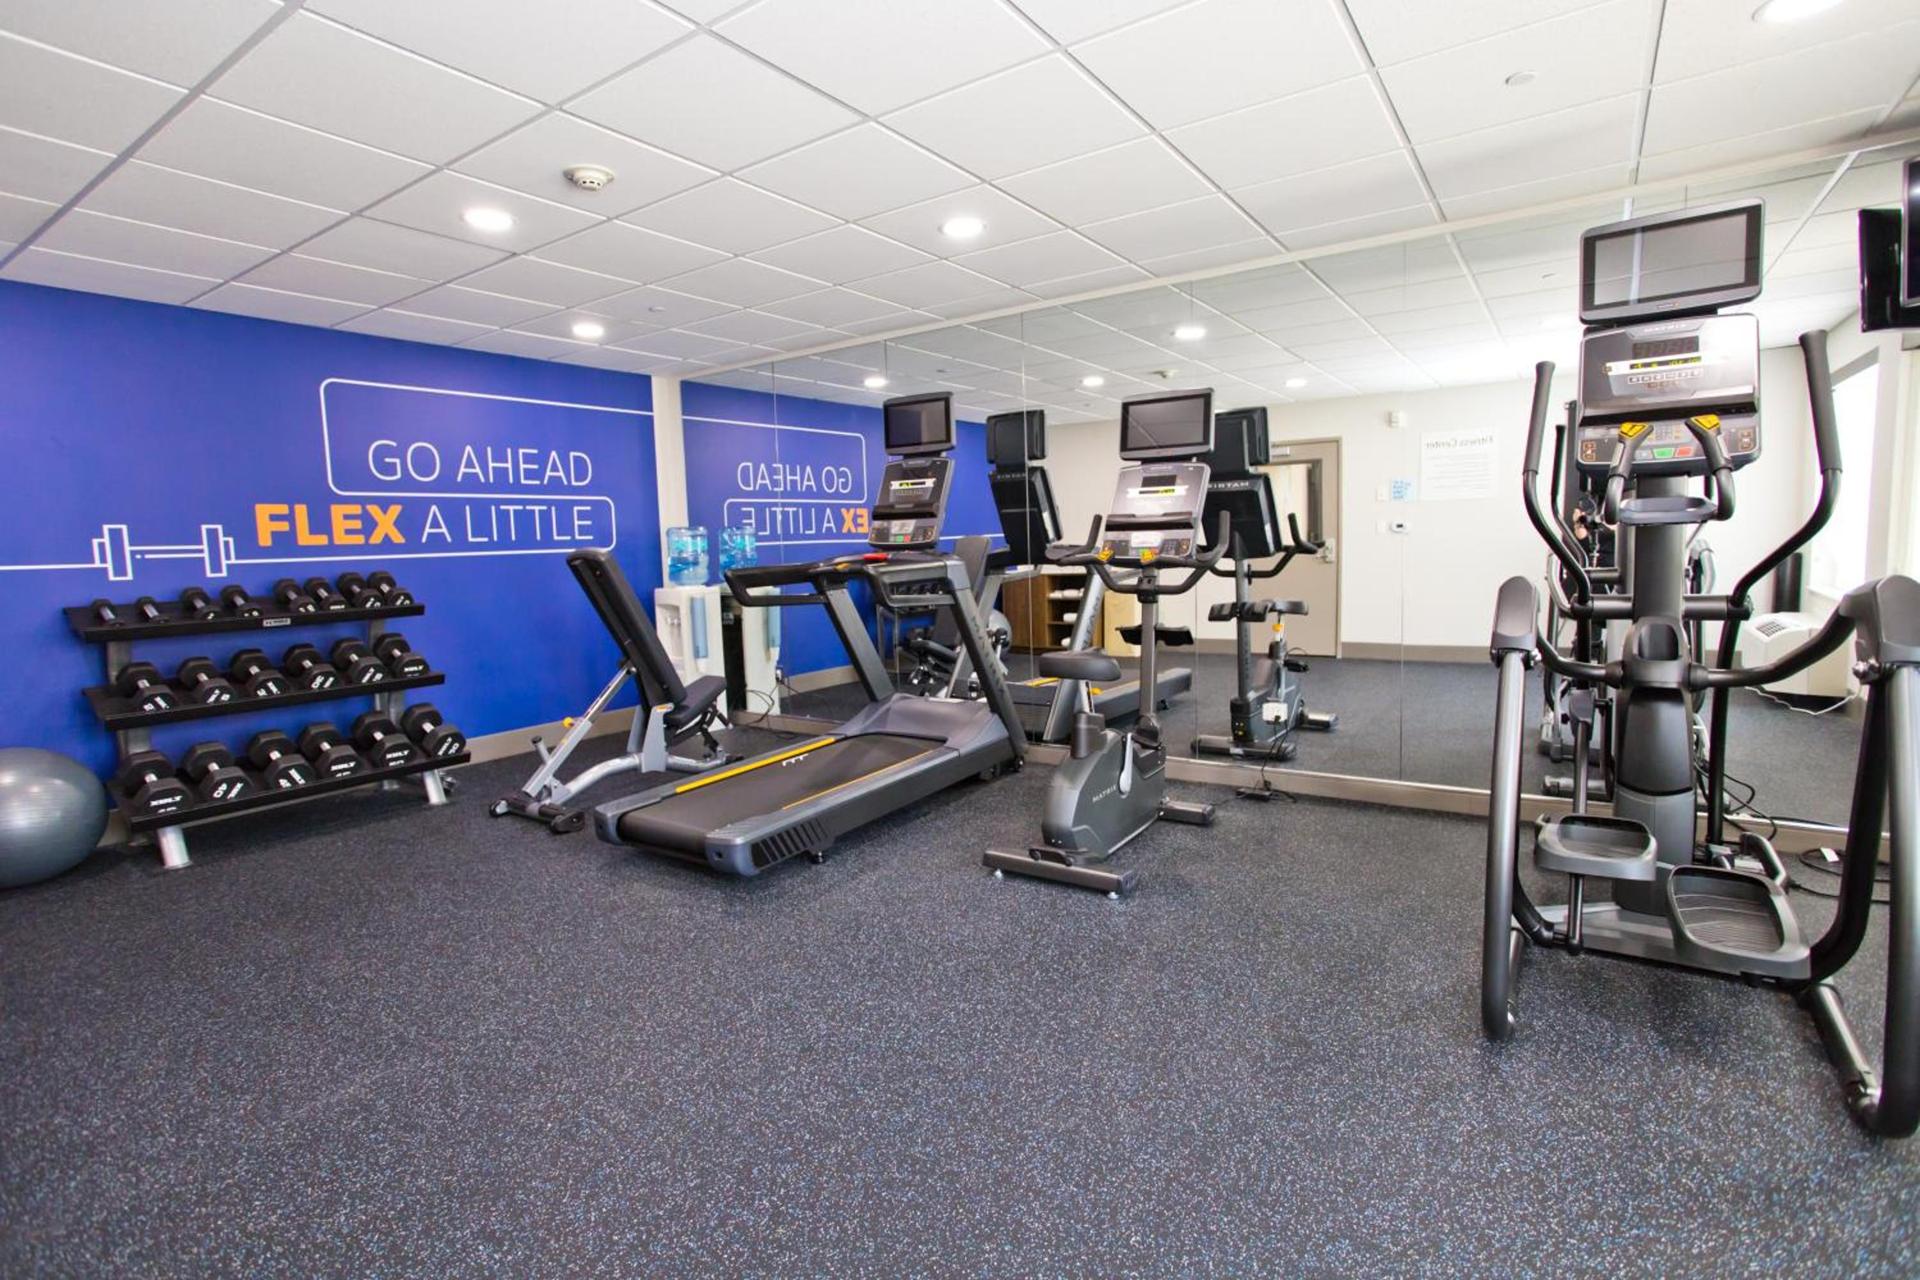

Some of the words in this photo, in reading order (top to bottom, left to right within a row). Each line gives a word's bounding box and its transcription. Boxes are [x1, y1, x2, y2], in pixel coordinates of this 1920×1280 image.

[368, 439, 441, 482] GO
[456, 444, 593, 487] AHEAD
[254, 503, 406, 547] FLEX
[421, 504, 452, 543] A
[465, 504, 594, 543] LITTLE
